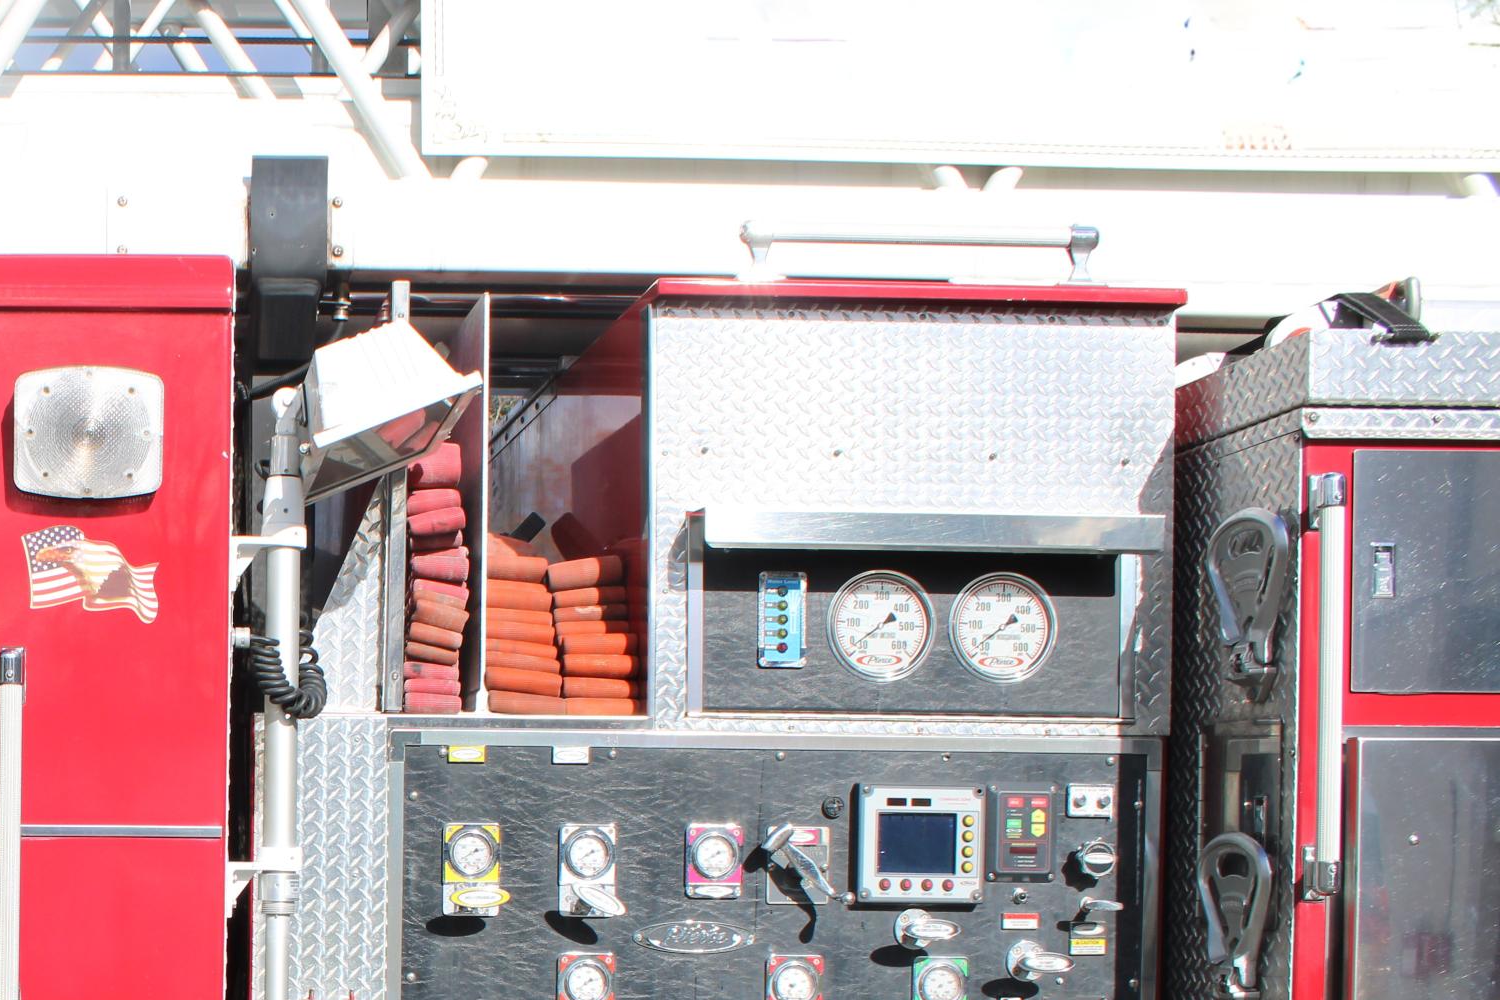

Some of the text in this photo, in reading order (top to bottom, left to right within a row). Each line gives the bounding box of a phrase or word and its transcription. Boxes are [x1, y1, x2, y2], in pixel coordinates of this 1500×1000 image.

[875, 590, 890, 601] 300
[995, 593, 1011, 602] 300
[853, 600, 869, 610] 200
[893, 603, 910, 613] 400
[975, 602, 991, 611] 200
[1015, 605, 1031, 615] 400
[846, 617, 860, 627] 100
[899, 621, 915, 631] 500
[968, 620, 983, 630] 100
[1020, 624, 1036, 633] 500
[891, 640, 907, 650] 600
[868, 655, 893, 664] Pierce
[989, 658, 1014, 666] Pierce
